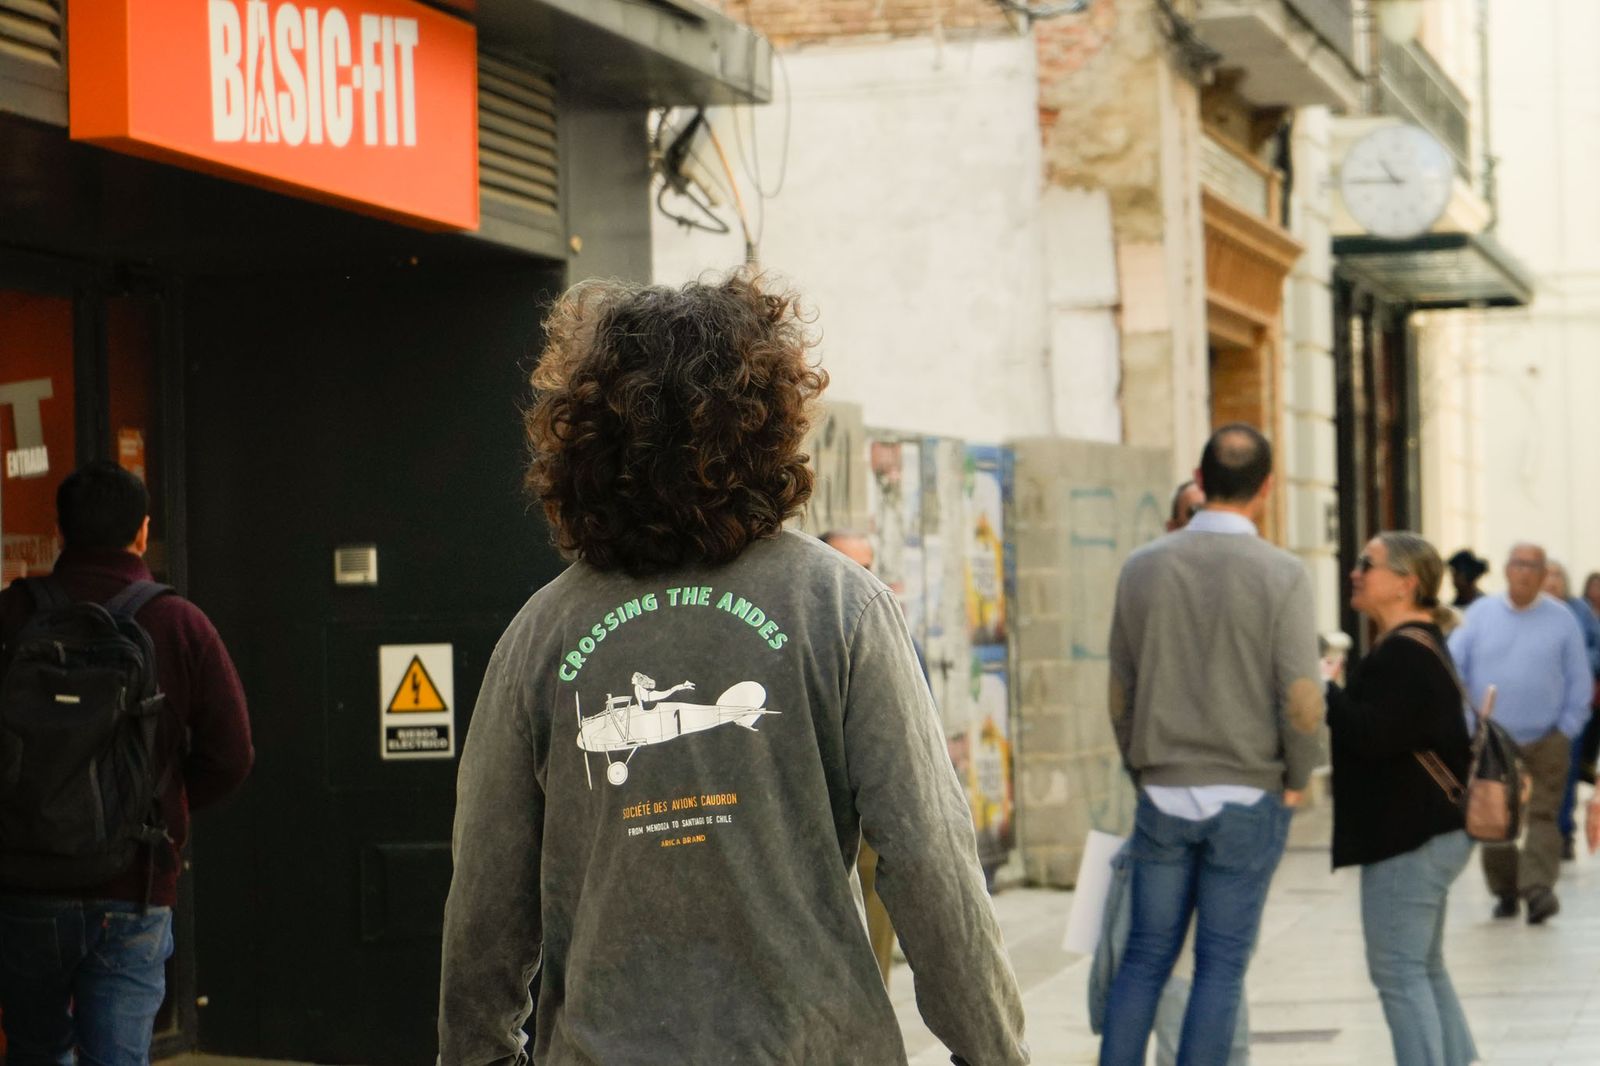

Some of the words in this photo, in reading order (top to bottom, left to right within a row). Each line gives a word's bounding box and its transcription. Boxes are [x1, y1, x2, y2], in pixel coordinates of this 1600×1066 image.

[558, 593, 659, 682] CROSSING
[666, 586, 713, 607] THE
[716, 592, 788, 650] ANDES
[673, 708, 682, 735] 1
[622, 800, 651, 819] SOCIÉTÉ
[653, 801, 668, 814] DES
[671, 796, 698, 811] AVIONS
[701, 793, 737, 806] CAUDRON
[628, 827, 644, 836] FROM
[645, 822, 670, 833] MENDOZA
[672, 820, 680, 829] TO
[681, 817, 705, 827] SANTIAGO
[705, 816, 713, 824] DE
[716, 814, 732, 823] CHILE
[682, 834, 706, 845] BRAND
